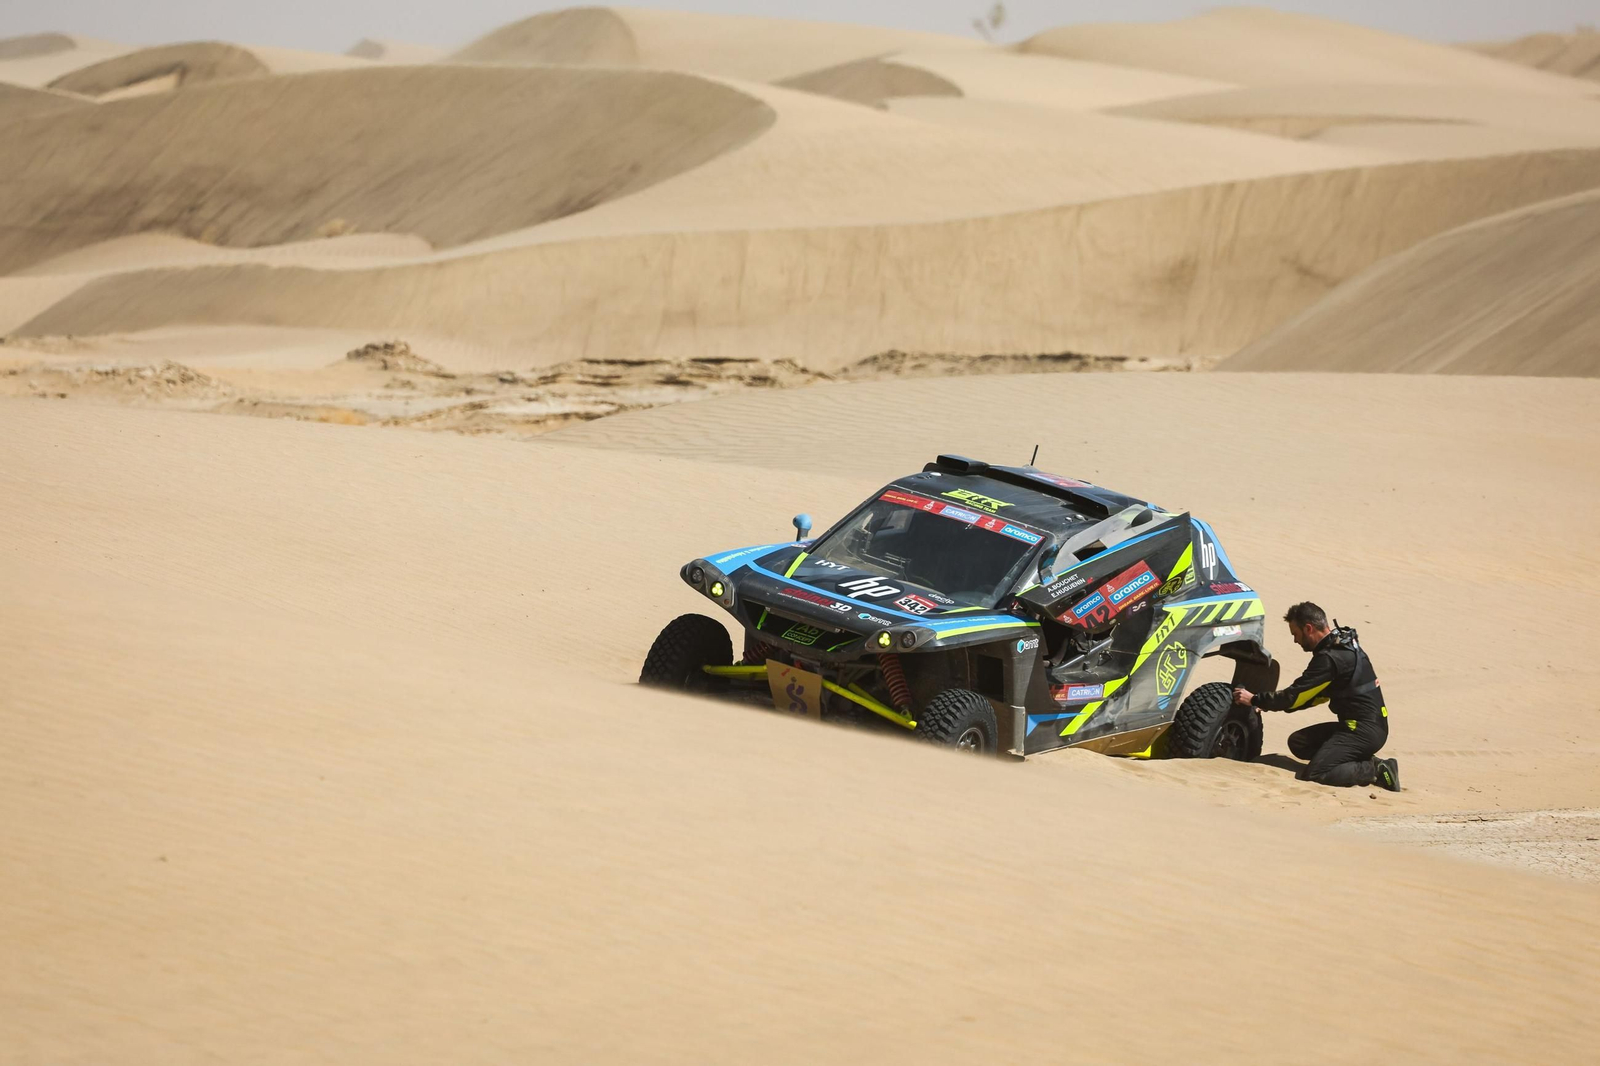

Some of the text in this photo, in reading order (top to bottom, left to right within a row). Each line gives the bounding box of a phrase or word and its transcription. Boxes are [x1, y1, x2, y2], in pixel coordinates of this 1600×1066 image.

[945, 508, 977, 521] CATRION
[1004, 527, 1038, 542] aramco
[1199, 529, 1216, 581] hp
[815, 559, 850, 571] HYT
[838, 576, 901, 599] hp
[1113, 574, 1150, 601] aramco
[898, 598, 928, 614] 342
[1075, 595, 1101, 615] aramco
[1155, 614, 1176, 643] HYT
[1071, 688, 1100, 697] CATRION
